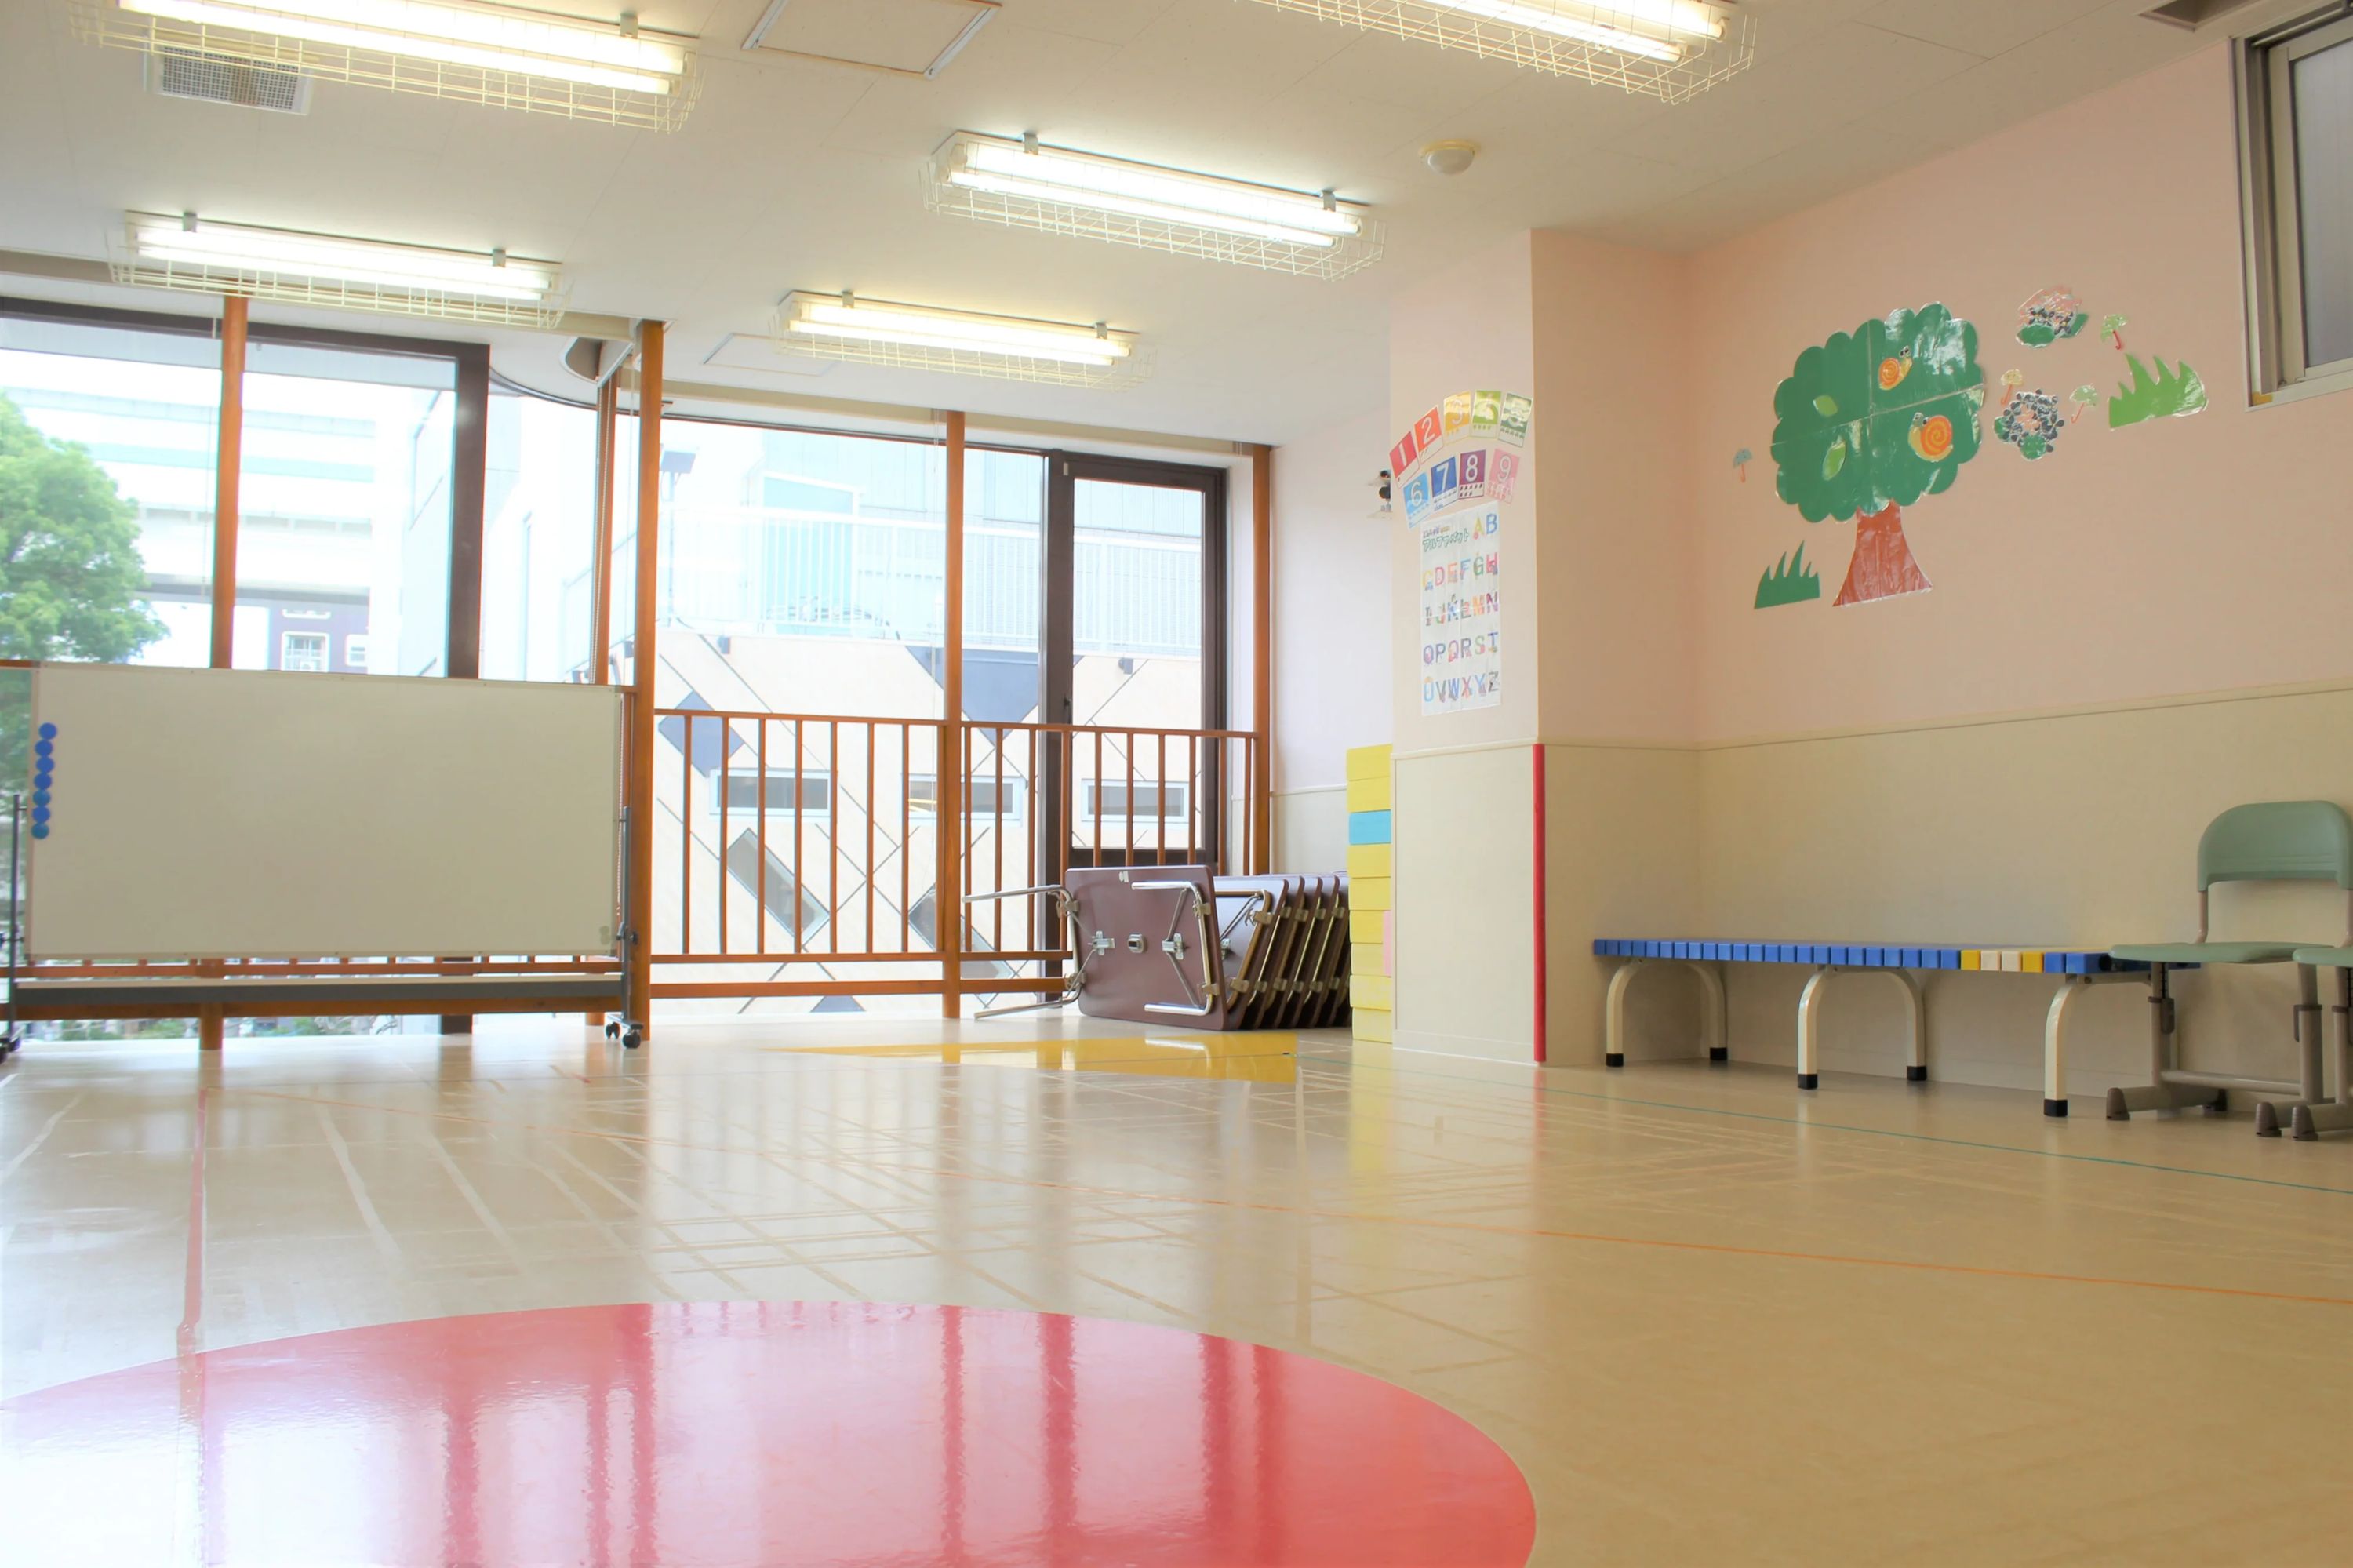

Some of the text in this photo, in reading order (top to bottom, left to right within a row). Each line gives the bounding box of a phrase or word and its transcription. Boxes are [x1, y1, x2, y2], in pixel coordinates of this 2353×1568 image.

[1398, 442, 1407, 467] 1
[1420, 417, 1435, 445] 2
[1451, 398, 1464, 425] 3
[1410, 453, 1512, 508] 6 7 8 9
[1486, 513, 1498, 534] B
[1435, 566, 1445, 587] D
[1447, 562, 1458, 584] E
[1460, 558, 1471, 580] F
[1473, 555, 1484, 577] G
[1423, 644, 1434, 664] O
[1435, 643, 1446, 663] P
[1460, 638, 1472, 659] R
[1474, 635, 1486, 655] S
[1487, 631, 1499, 653] T
[1435, 679, 1446, 703] V
[1448, 677, 1460, 701] W
[1461, 675, 1472, 698] X
[1474, 673, 1486, 695] Y
[1488, 671, 1499, 693] Z
